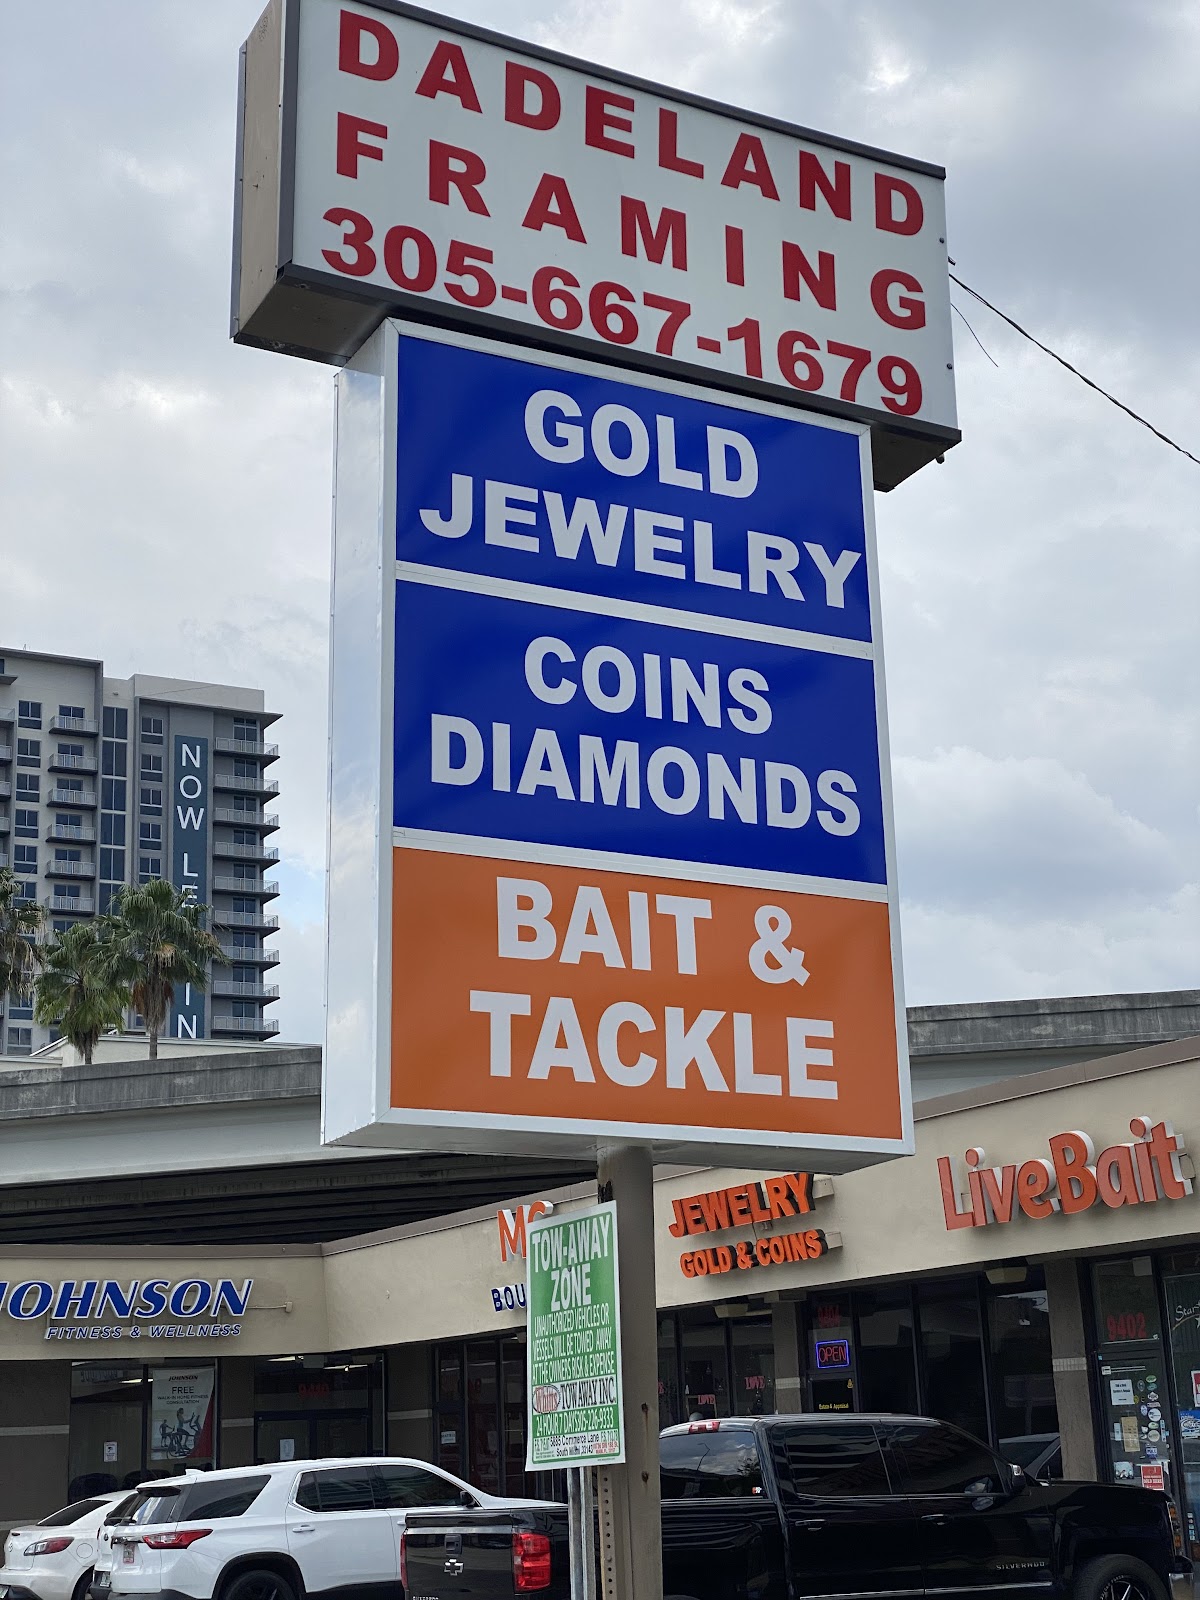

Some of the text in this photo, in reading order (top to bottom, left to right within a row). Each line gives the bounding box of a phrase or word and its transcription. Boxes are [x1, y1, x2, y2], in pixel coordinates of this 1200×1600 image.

[338, 9, 924, 236] DADELAND
[336, 112, 926, 331] FRAMING
[322, 207, 923, 416] 305-667-1679
[525, 390, 759, 498] GOLD
[420, 474, 862, 609] JEWELRY
[525, 636, 772, 735] COINS
[431, 714, 861, 837] DIAMONDS
[177, 743, 204, 1038] NOW LEIN
[496, 877, 811, 987] BAIT &
[470, 990, 839, 1100] TACKLE
[668, 1172, 812, 1238] JEWELRY
[532, 1215, 611, 1274] TOW-AWAY
[680, 1230, 823, 1279] GOLD & COINS
[491, 1284, 527, 1312] BOU
[551, 1263, 592, 1311] ZONE
[47, 1323, 242, 1339] FITNESS & WELLNESS
[532, 1326, 612, 1362] VESSELS WILL BE TOWED AWAY
[534, 1304, 610, 1338] UNAUTHORIZED VEHICLES OR
[1106, 1312, 1147, 1341] 9402
[539, 1362, 549, 1384] THE
[571, 1355, 584, 1380] RISK
[589, 1351, 615, 1376] EXPENSE
[818, 1345, 847, 1363] OPEN
[171, 1386, 195, 1394] FREE
[560, 1382, 578, 1410] TOW
[578, 1378, 598, 1407] AWAY
[536, 1415, 543, 1437] 24
[543, 1413, 559, 1435] HOUR
[559, 1413, 563, 1433] 7
[564, 1410, 577, 1433] DAYS
[587, 1432, 600, 1442] Lane
